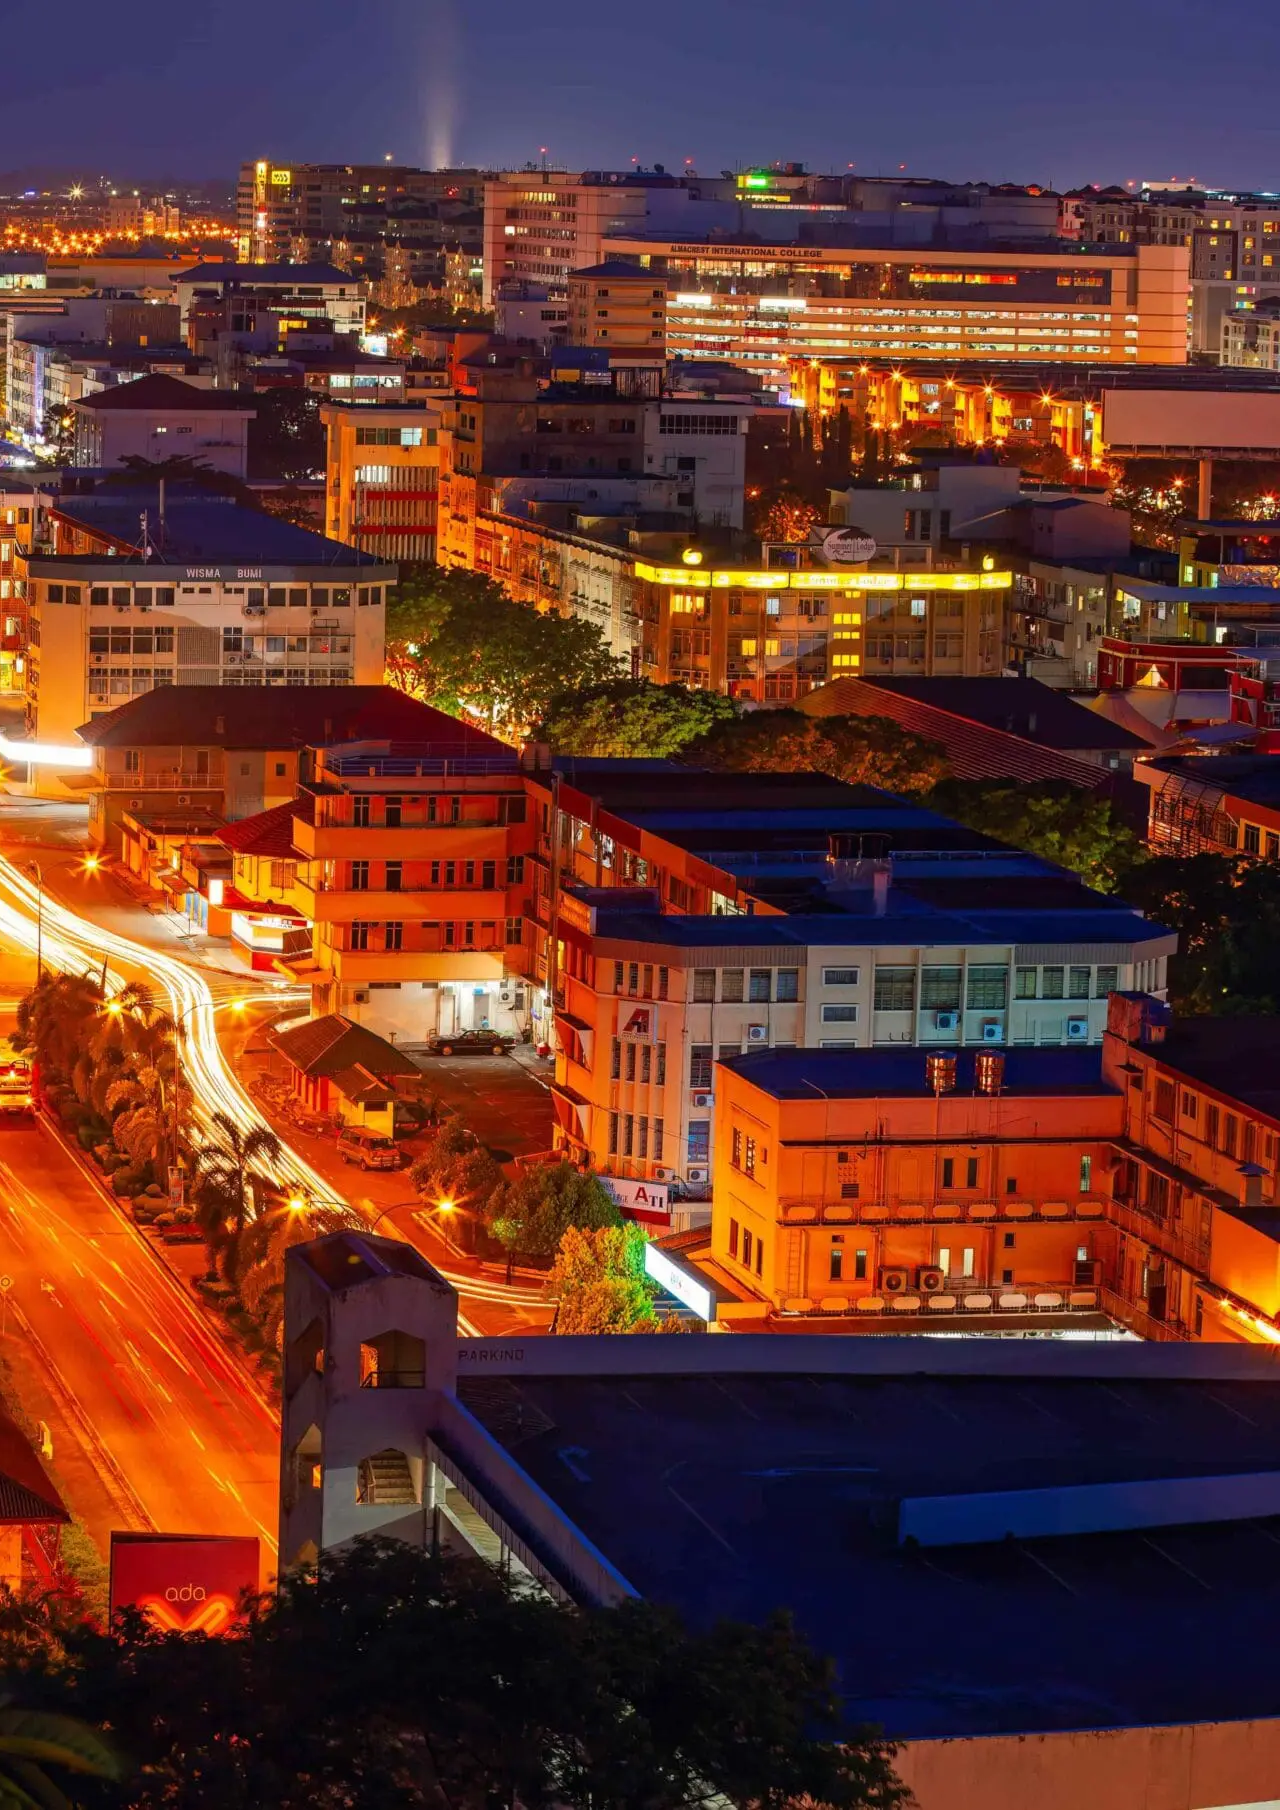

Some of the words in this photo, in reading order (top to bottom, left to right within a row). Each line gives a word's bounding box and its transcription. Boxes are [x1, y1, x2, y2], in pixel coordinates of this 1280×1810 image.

[671, 245, 710, 254] ALMACREST
[712, 246, 778, 256] INTERNATIONAL
[780, 248, 823, 258] COLLEGE
[186, 568, 221, 578] WISMA
[237, 568, 262, 578] BUMI
[165, 1583, 207, 1602] ada
